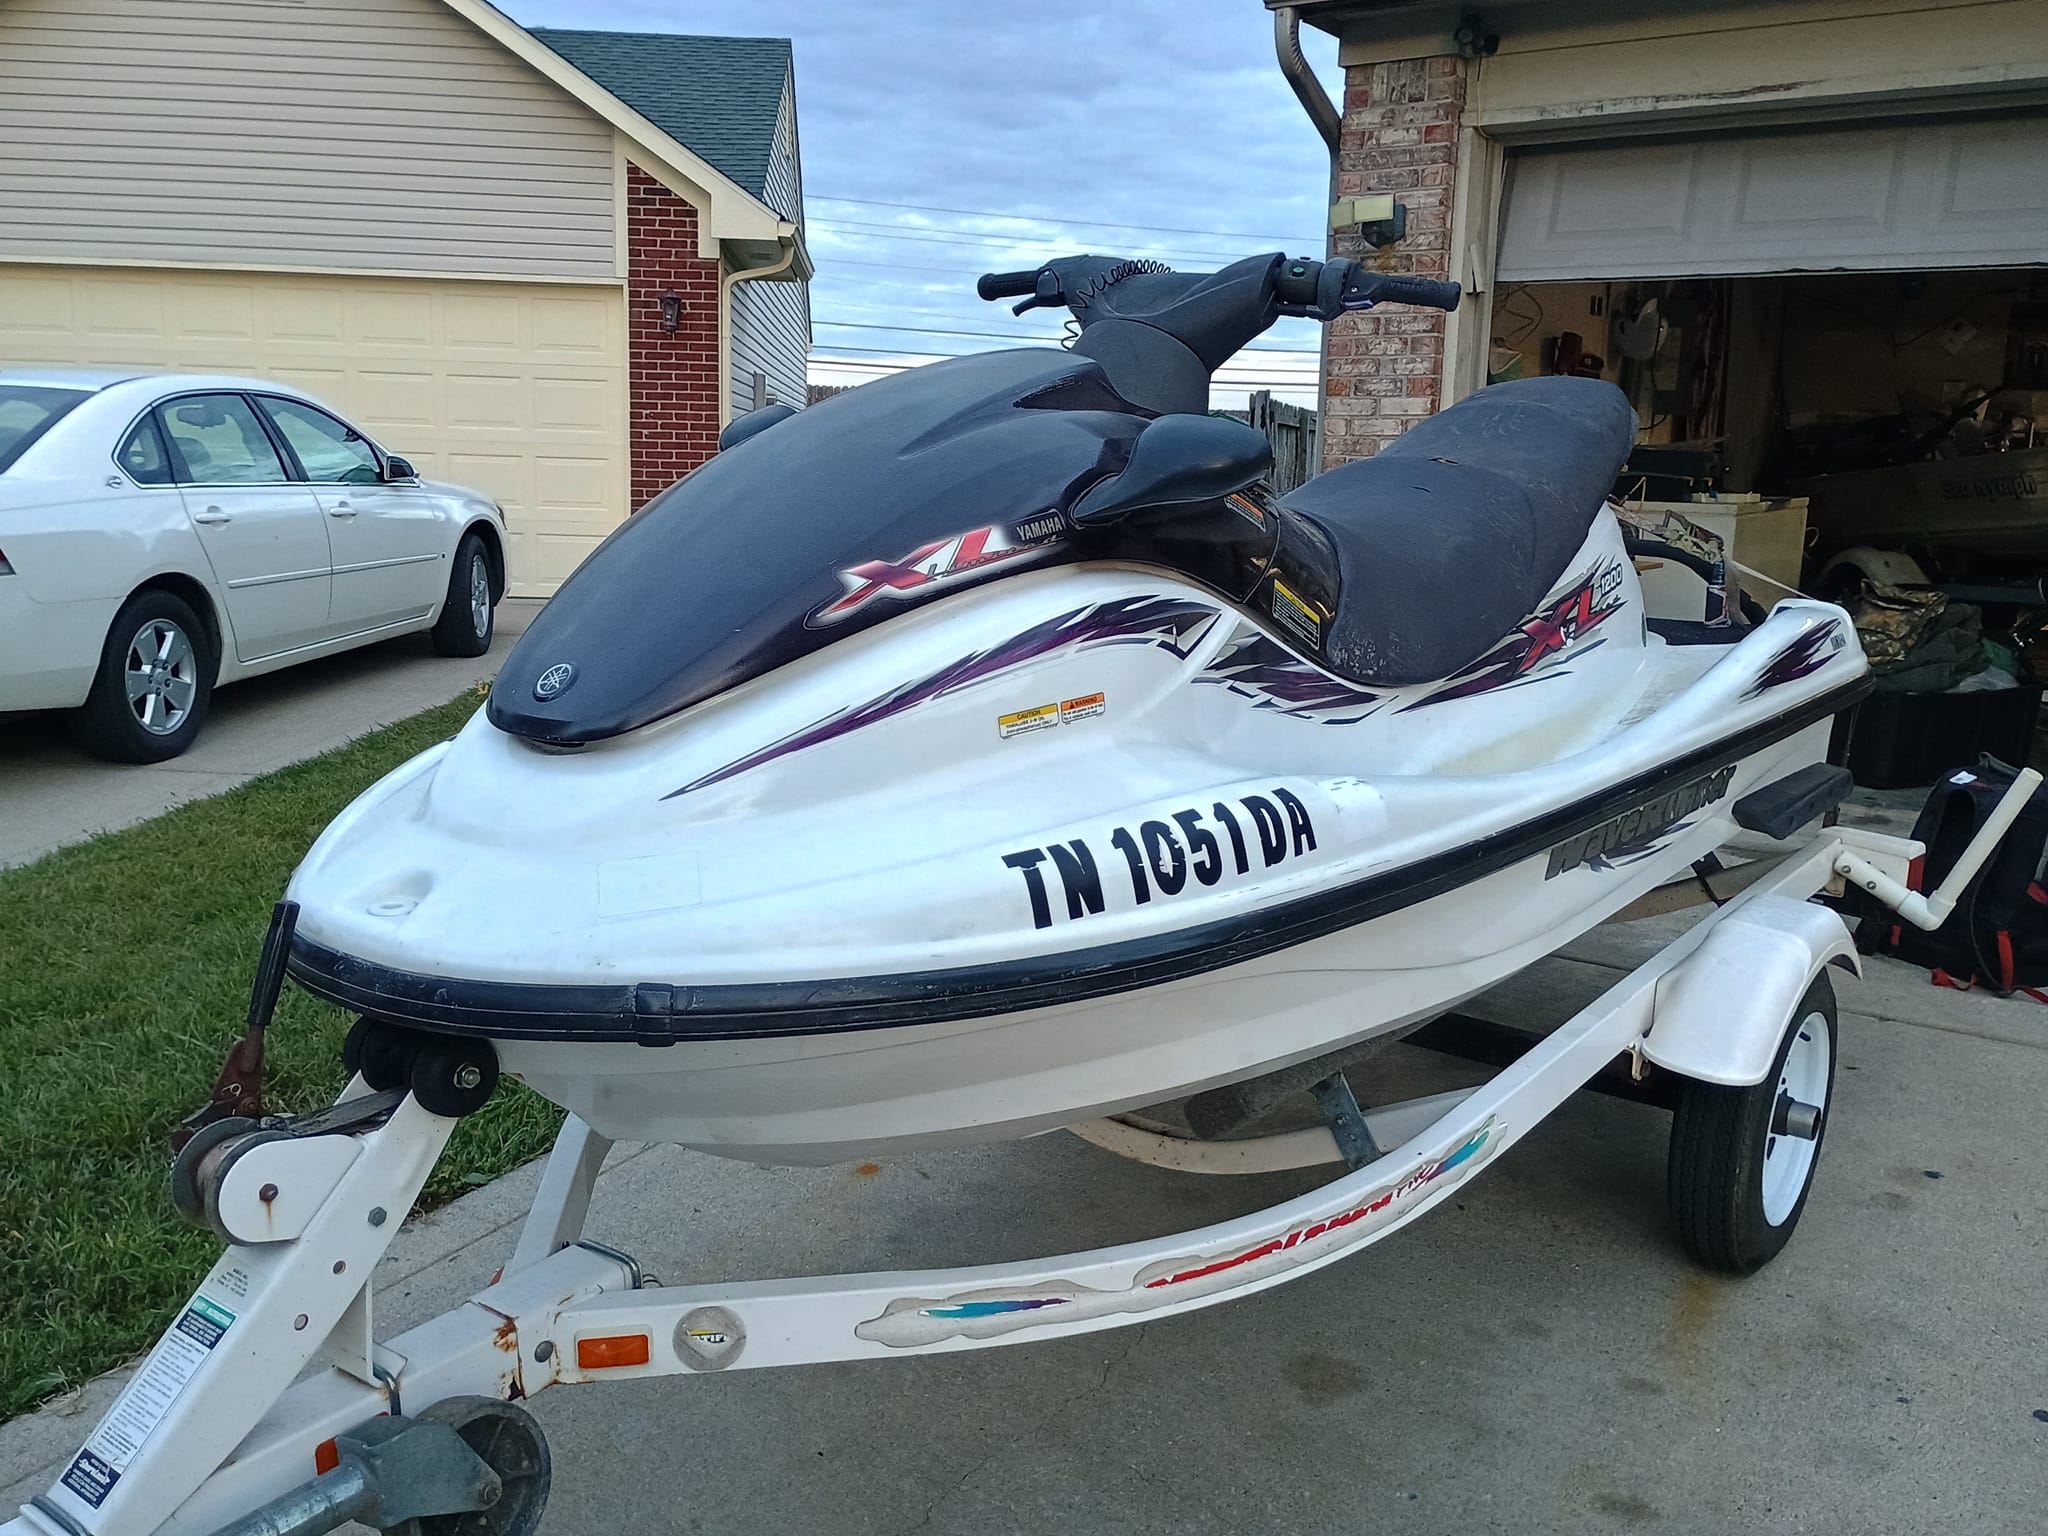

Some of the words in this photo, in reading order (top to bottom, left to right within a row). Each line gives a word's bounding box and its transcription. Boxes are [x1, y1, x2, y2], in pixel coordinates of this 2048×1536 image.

[1016, 516, 1062, 542] YAMAHA
[818, 526, 1000, 616] XL
[1600, 563, 1622, 596] 1200
[1514, 584, 1628, 674] XL
[1016, 709, 1041, 721] CAUTION
[1001, 839, 1105, 930] TN
[1111, 801, 1249, 905] 1051
[1239, 787, 1317, 868] DA
